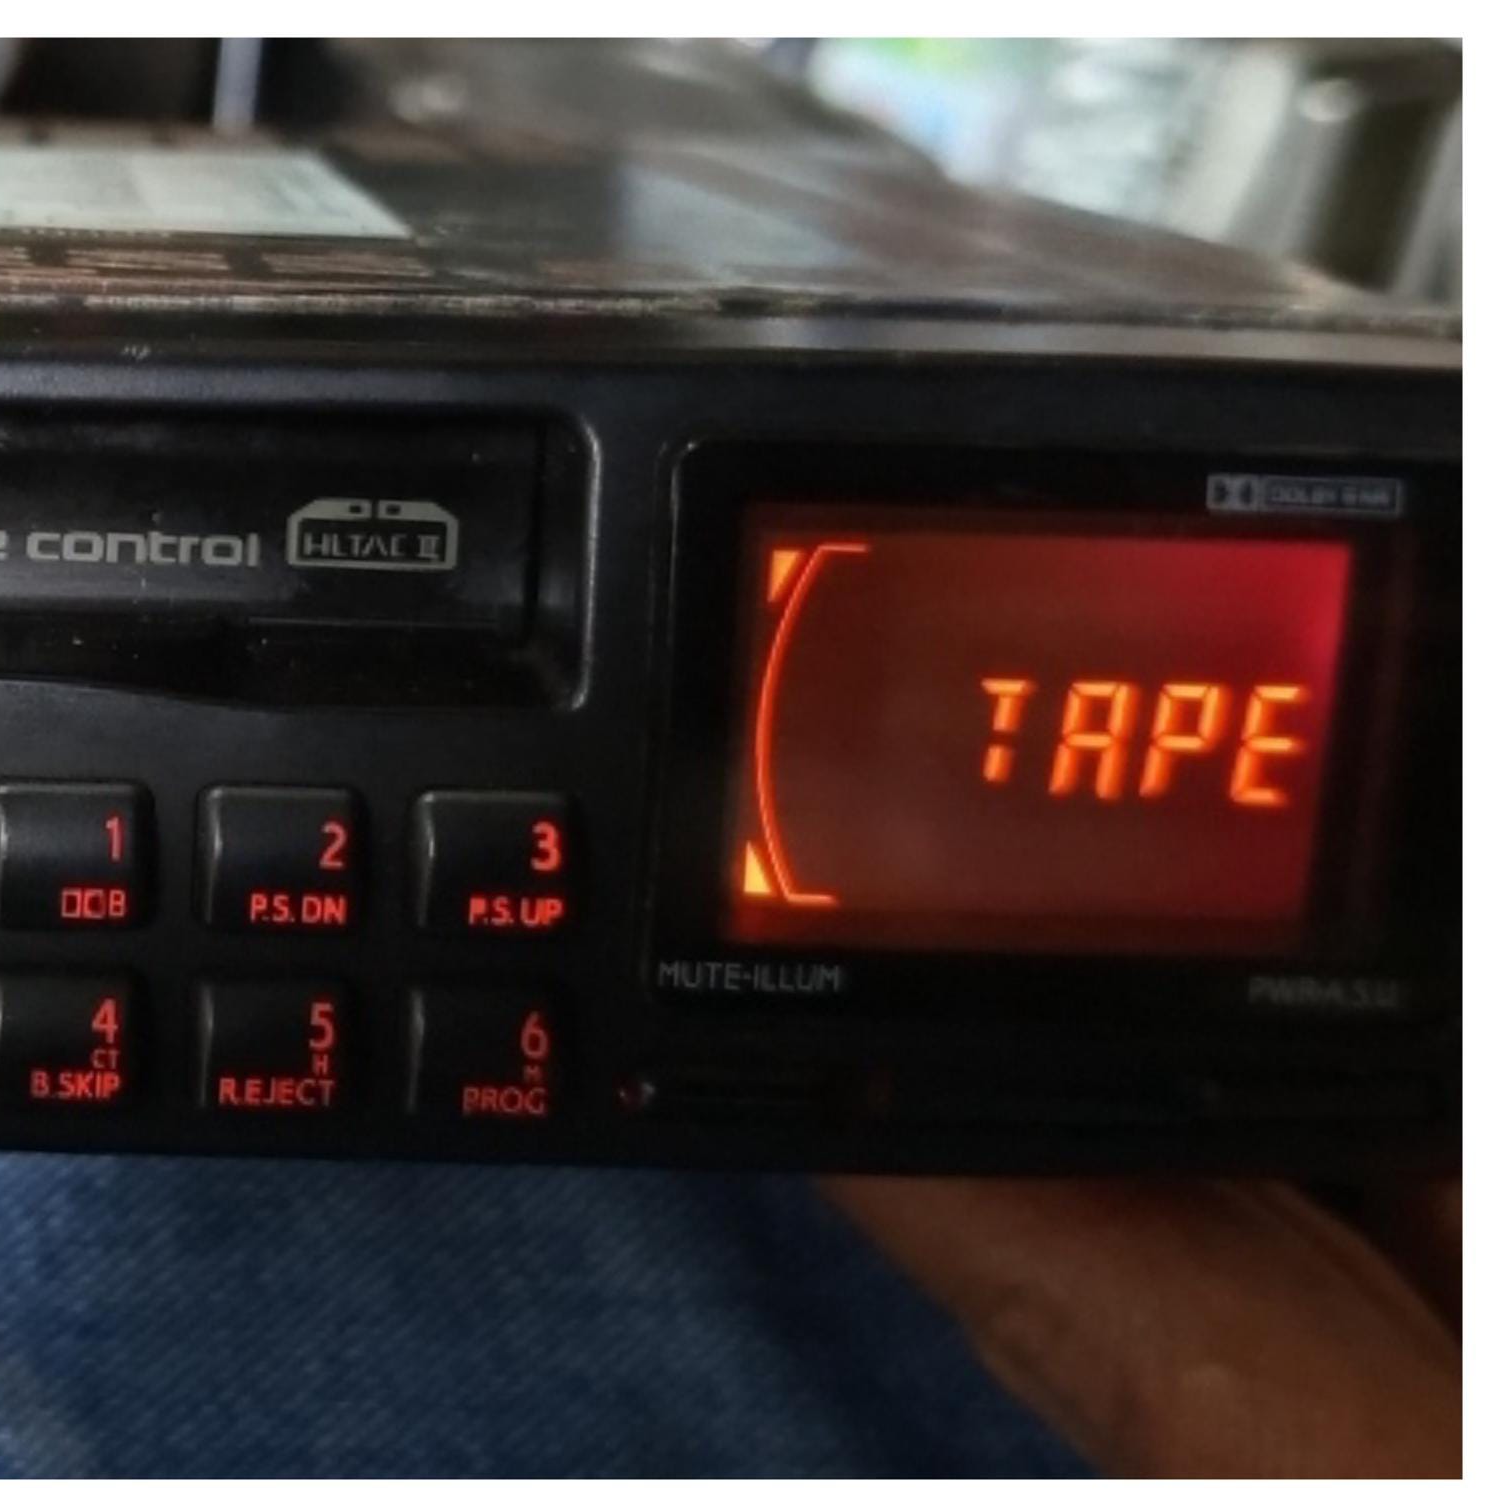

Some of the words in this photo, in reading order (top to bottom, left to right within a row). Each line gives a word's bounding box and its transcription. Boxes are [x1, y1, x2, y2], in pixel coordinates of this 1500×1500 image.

[26, 528, 259, 568] control
[981, 677, 1308, 806] TAPE
[104, 817, 122, 861] 1
[320, 822, 346, 869] 2
[531, 820, 562, 872] 3
[302, 894, 347, 924] DN
[520, 898, 565, 928] UP
[91, 999, 120, 1045] 4
[309, 1003, 336, 1050] 5
[520, 1012, 549, 1058] 6
[462, 1084, 548, 1115] PROG
